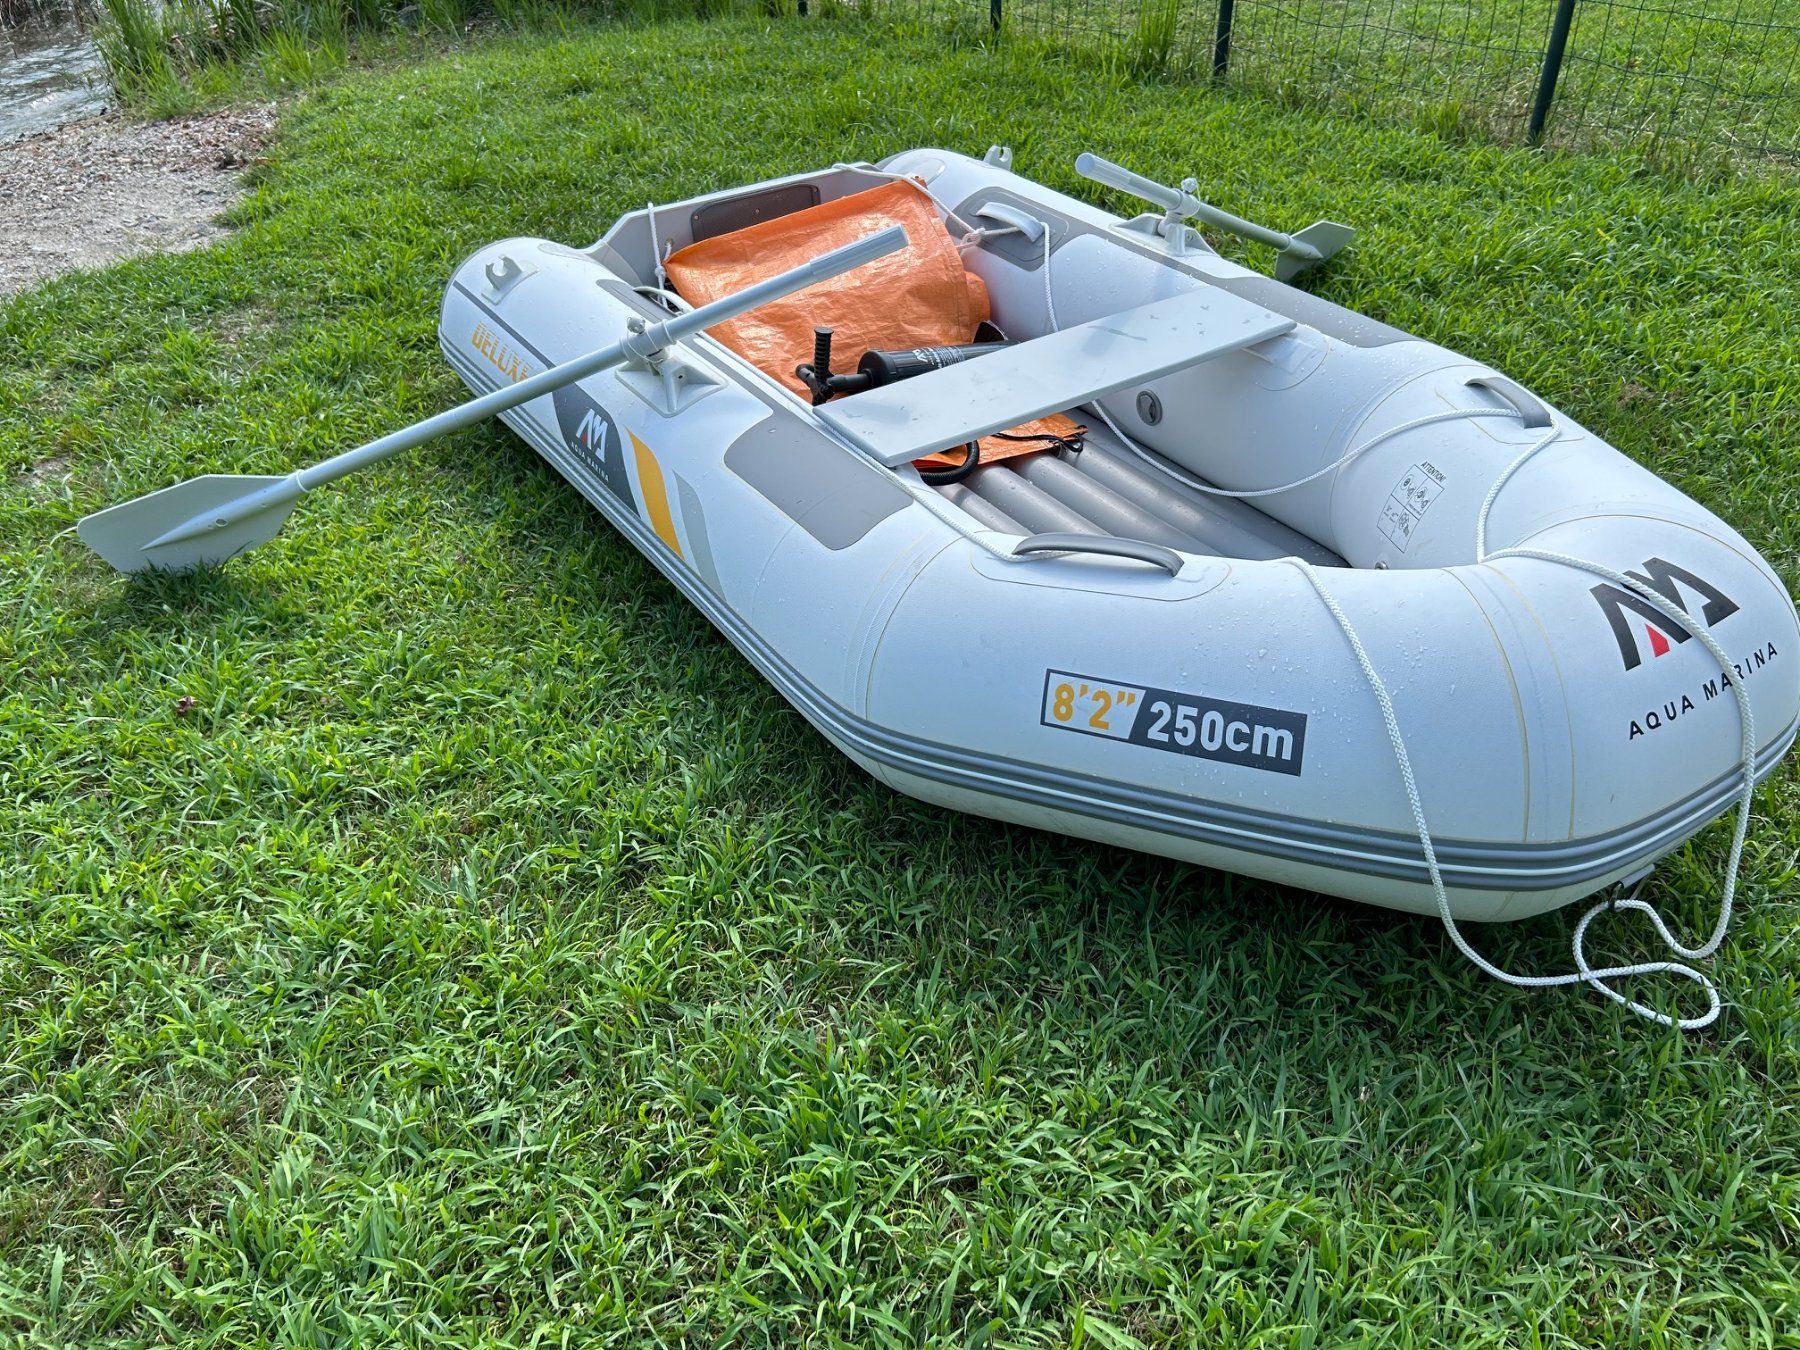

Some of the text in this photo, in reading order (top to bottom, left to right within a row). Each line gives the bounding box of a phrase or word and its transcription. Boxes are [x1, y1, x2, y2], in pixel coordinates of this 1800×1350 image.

[1146, 700, 1294, 761] 250cm
[1629, 641, 1778, 741] AQUA MARINA
